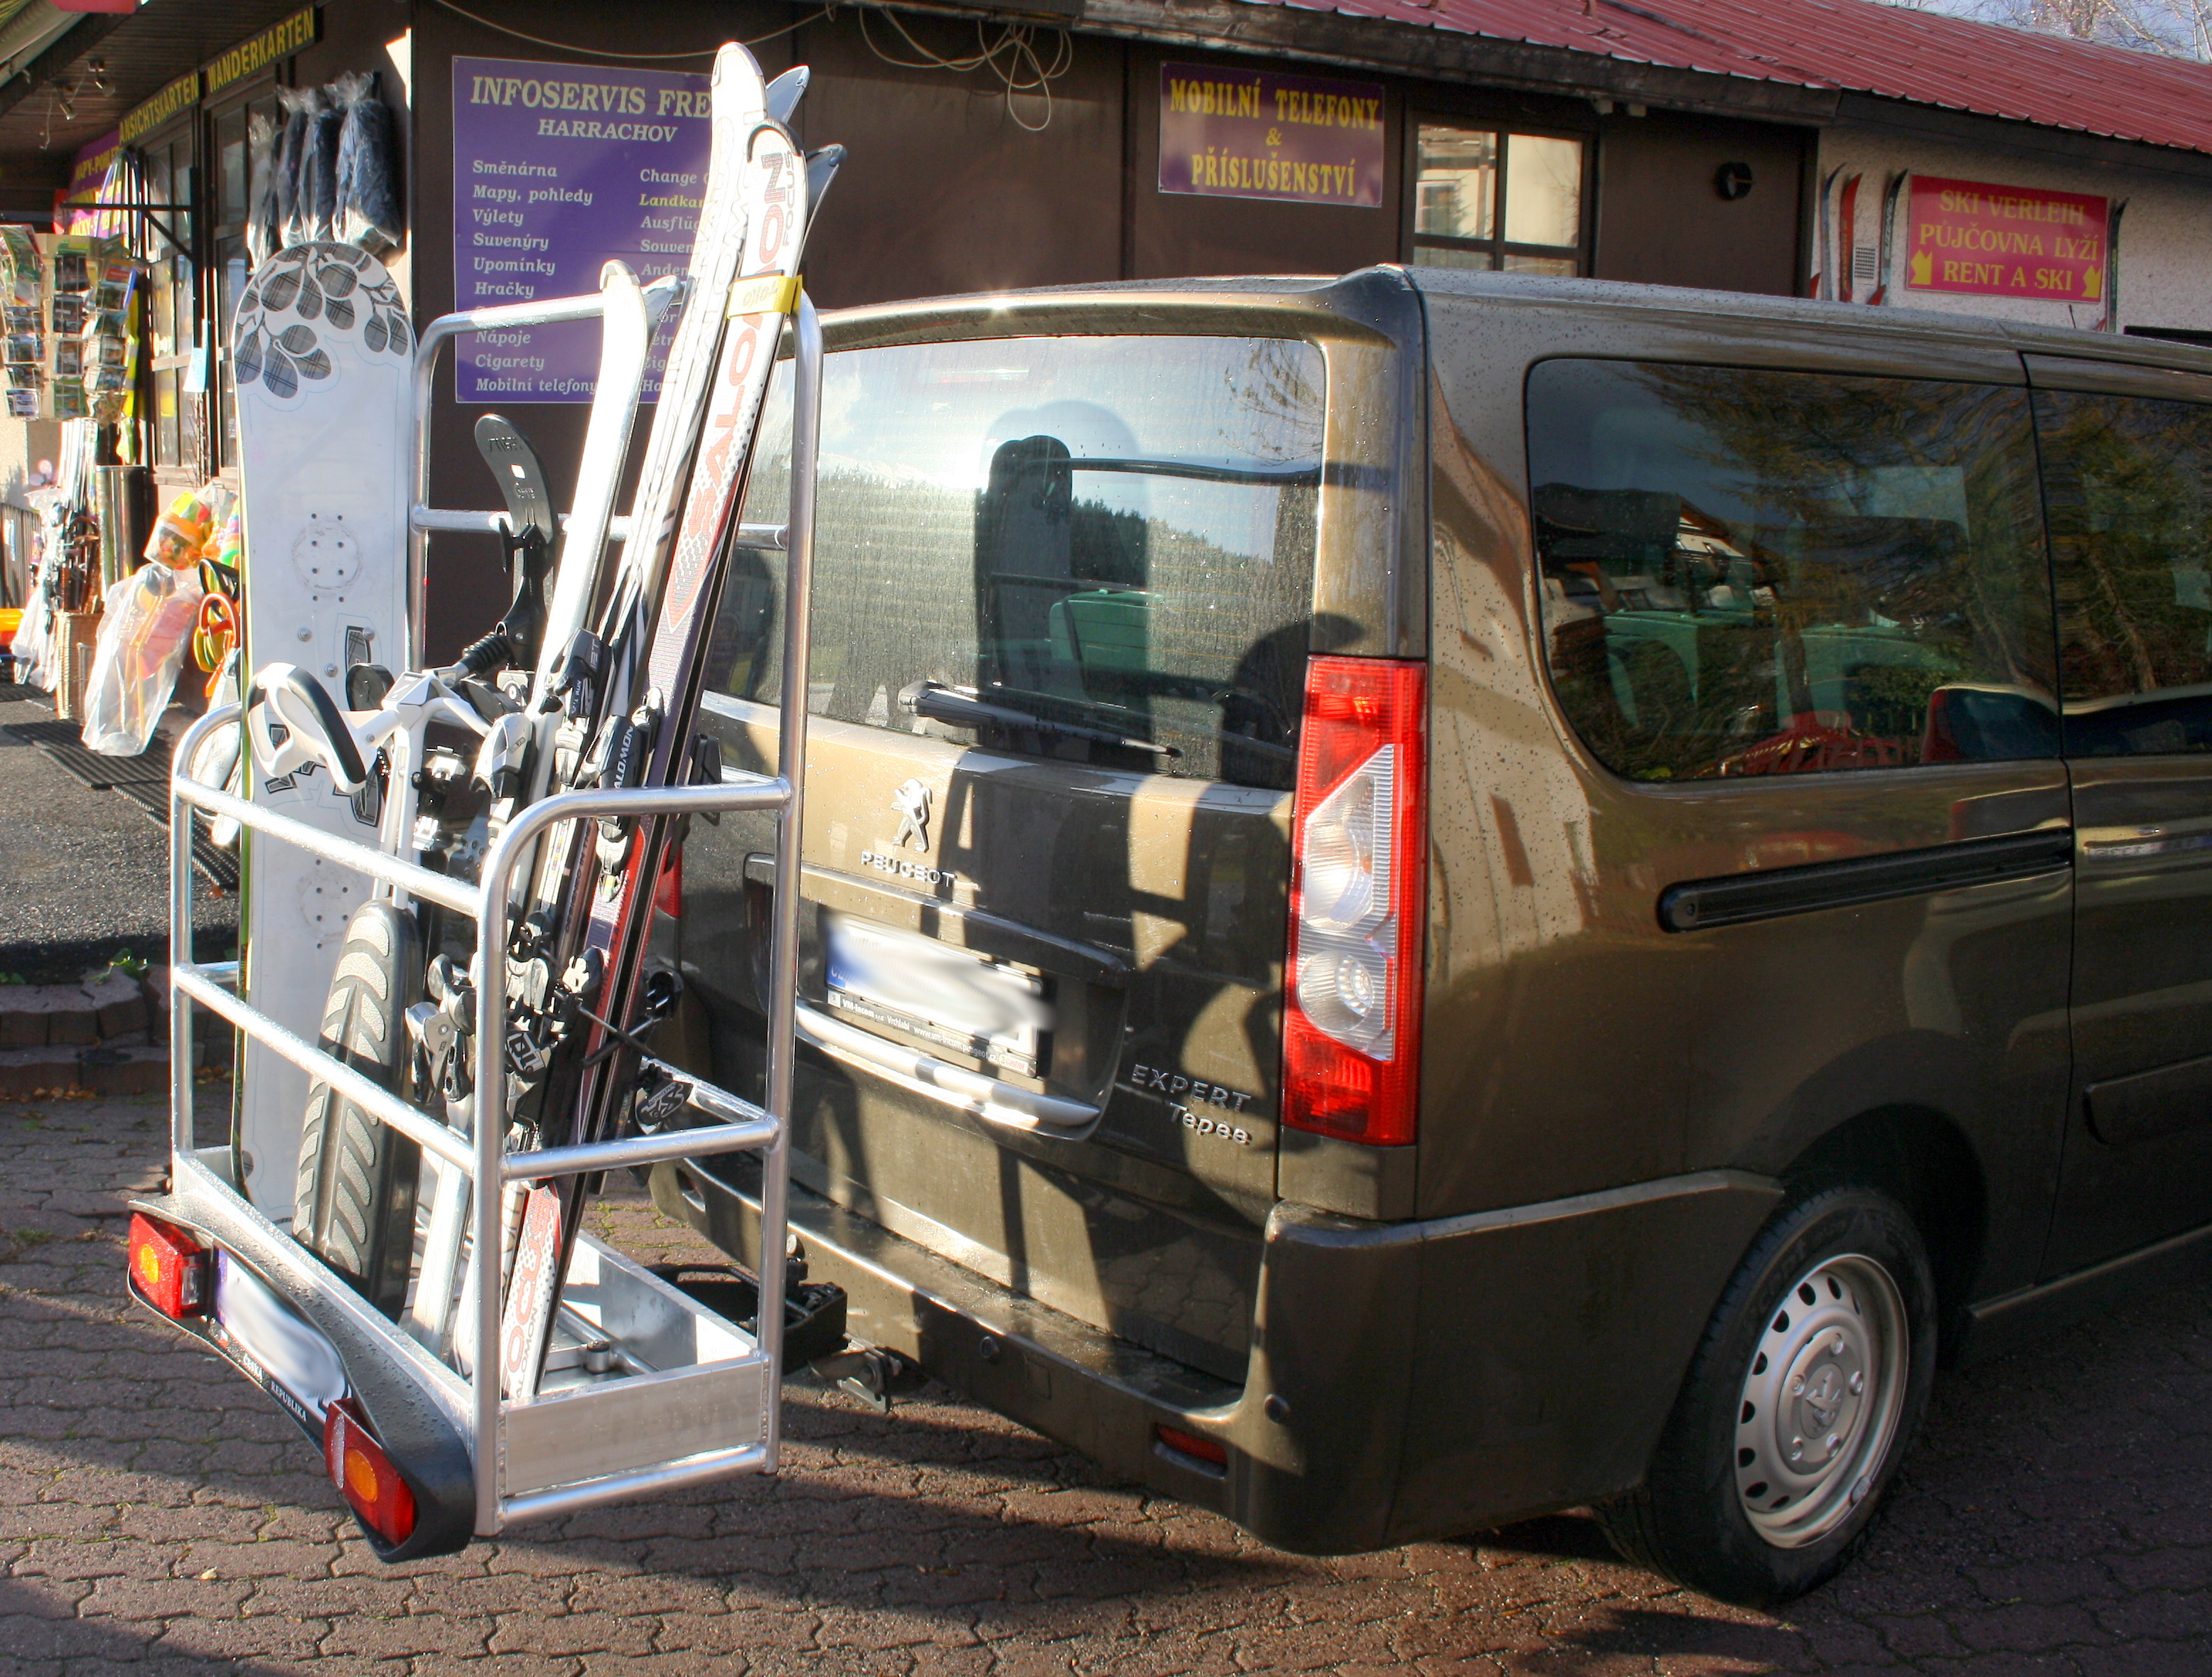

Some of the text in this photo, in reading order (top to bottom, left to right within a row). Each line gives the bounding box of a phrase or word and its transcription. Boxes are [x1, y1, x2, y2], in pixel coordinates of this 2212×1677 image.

[207, 6, 314, 93] WANDERKARTEN
[120, 73, 200, 143] ANSICHTSKARTEN
[471, 76, 646, 114] INFOSERVIS
[1170, 77, 1379, 131] MOBILNÍ TELEFONY
[537, 119, 678, 142] HARRACHOV
[1266, 127, 1282, 146] &
[473, 159, 557, 178] Směnárna
[640, 168, 697, 186] Change
[1191, 146, 1355, 197] PŘÍSLUŠENSTVÍ
[473, 185, 593, 205] Mapy, pohledy
[783, 149, 796, 247] FOCUS
[1939, 189, 2085, 226] SKI VERLEIH
[473, 208, 524, 227] Výlety
[473, 232, 549, 251] Suvenýry
[1919, 219, 2099, 260] PŮJČOVNA LYŽÍ
[473, 257, 556, 276] Upomínky
[1943, 260, 2073, 291] RENT A SKI
[474, 281, 535, 298] Hračky
[476, 330, 531, 346] Nápoje
[687, 152, 786, 539] SALOON
[475, 354, 544, 371] Cigarety
[476, 377, 596, 395] Mobilní telefony
[613, 725, 635, 789] ALOMON
[860, 851, 957, 888] PEUGEOT
[1132, 1064, 1252, 1112] EXPERT
[1169, 1102, 1252, 1145] Tepee
[517, 1307, 538, 1398] ALOMON
[271, 1381, 306, 1422] REPUBLIKA
